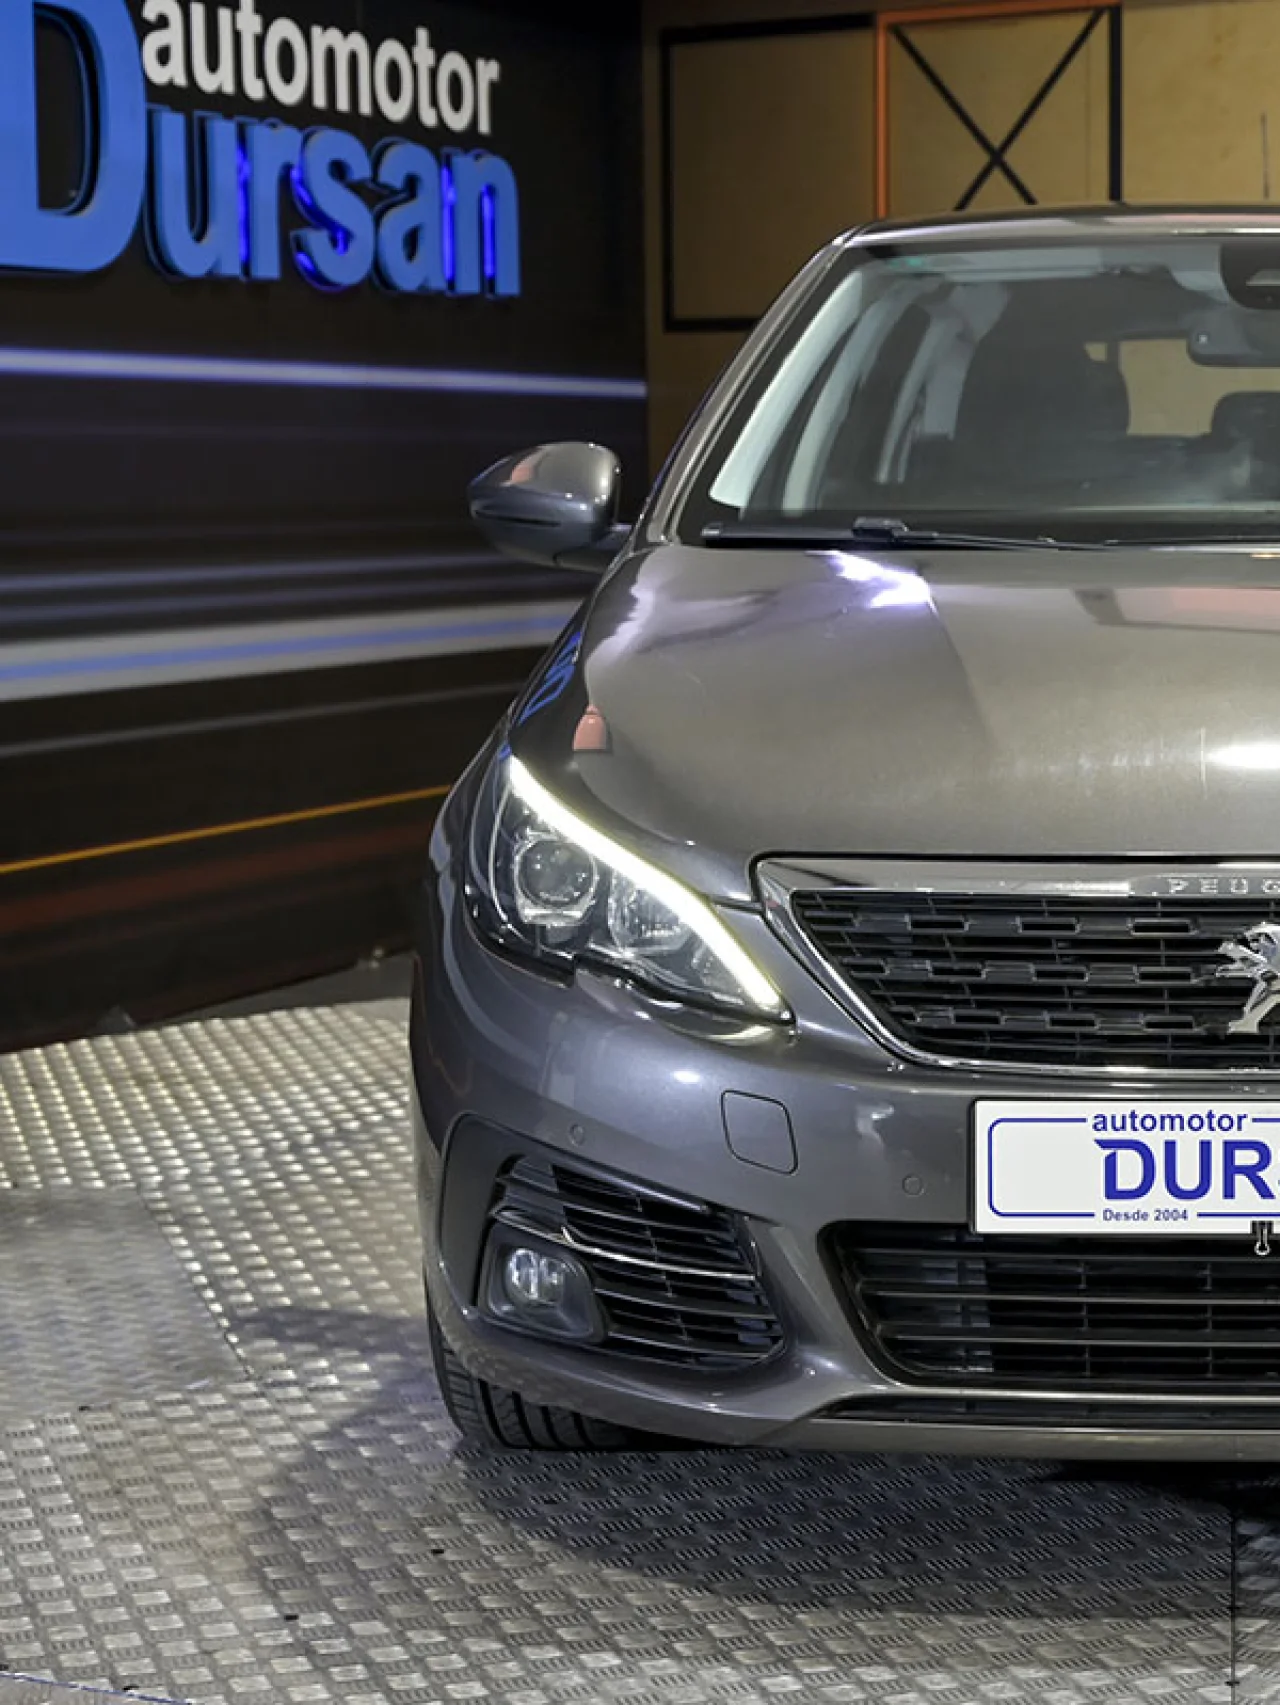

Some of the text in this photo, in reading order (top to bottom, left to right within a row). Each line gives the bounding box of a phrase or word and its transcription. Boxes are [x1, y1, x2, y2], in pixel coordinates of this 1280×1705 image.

[142, 0, 500, 134] automotor
[0, 0, 519, 298] Dursan
[1092, 1109, 1248, 1132] automotor
[1102, 1208, 1189, 1222] Desde 2004
